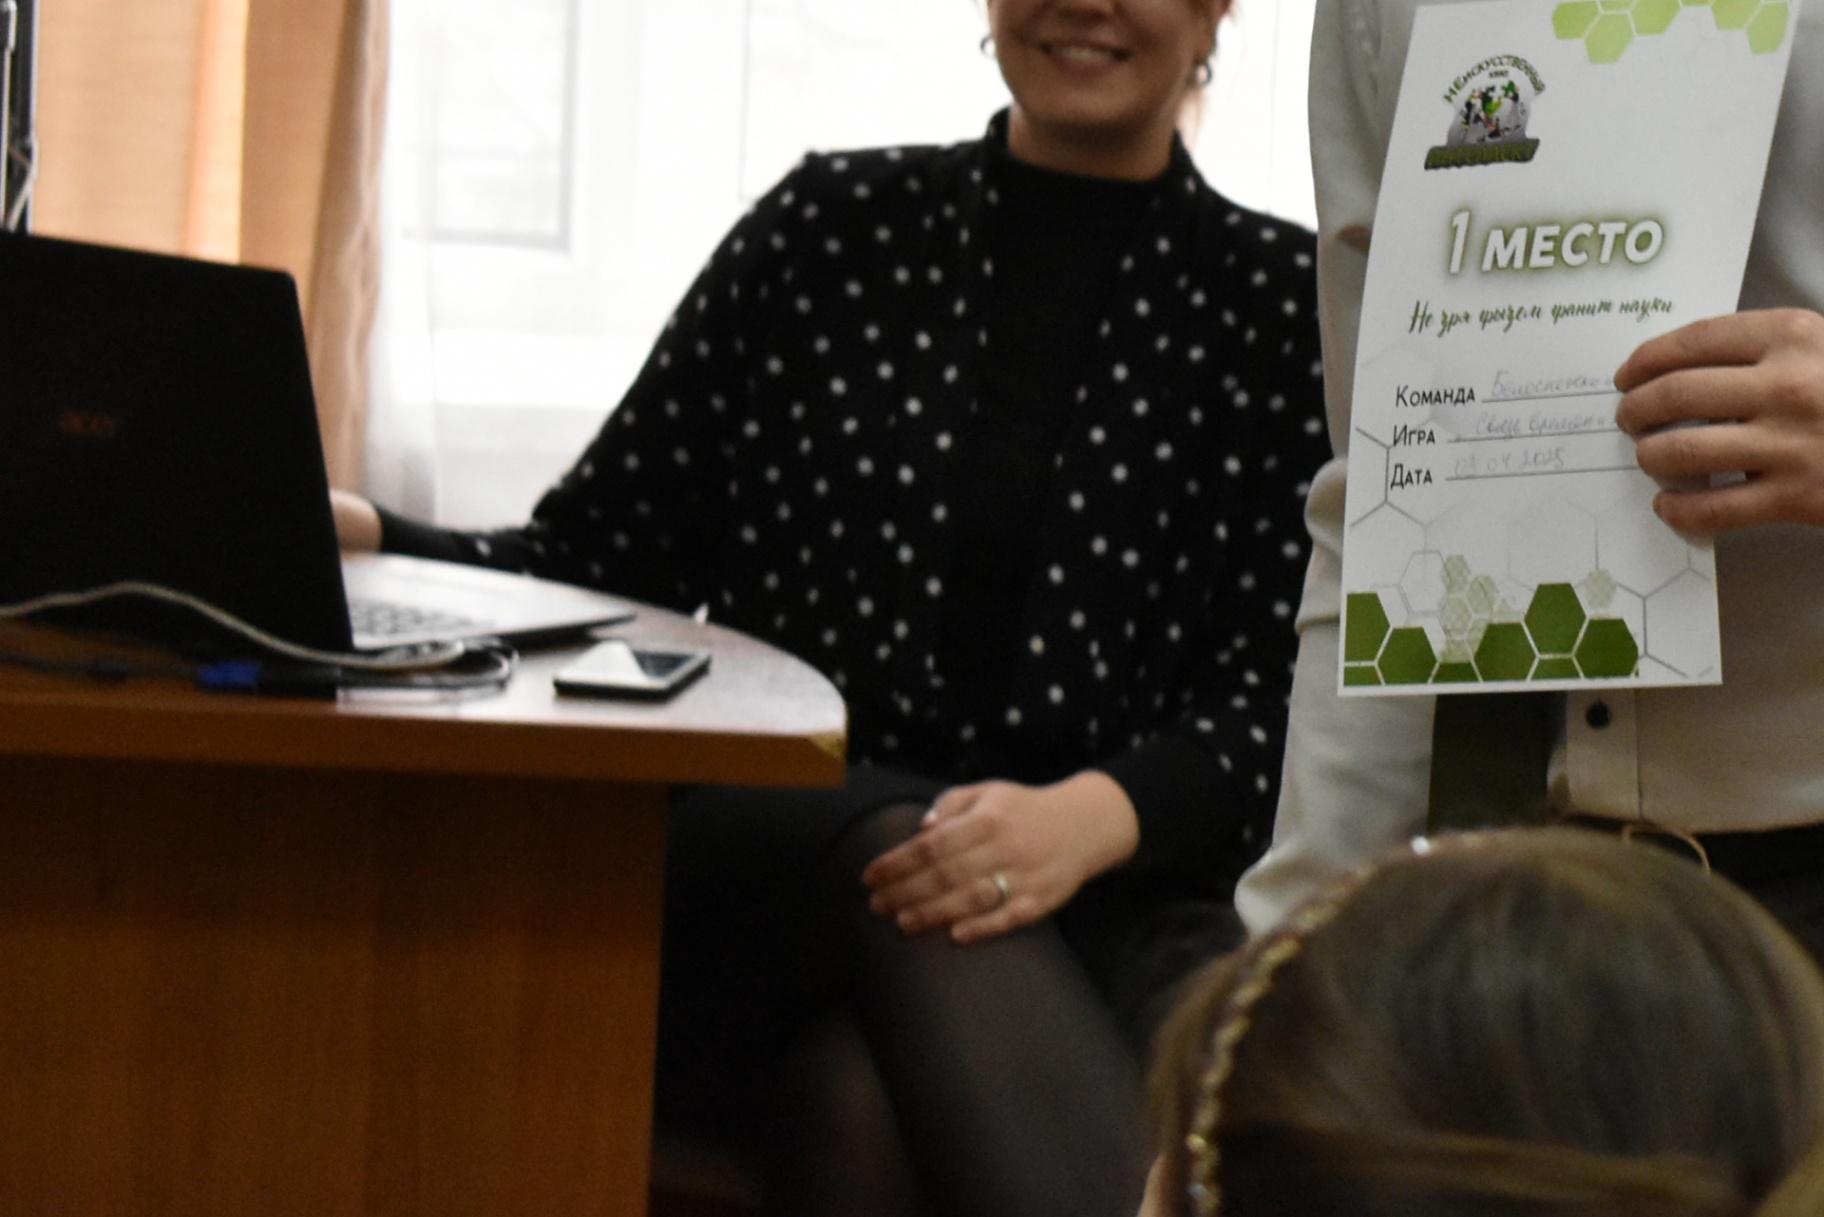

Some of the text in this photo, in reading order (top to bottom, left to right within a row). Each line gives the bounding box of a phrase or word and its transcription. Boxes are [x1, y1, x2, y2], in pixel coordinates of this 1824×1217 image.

[1448, 209, 1665, 274] 1 МЕСТО
[1408, 300, 1433, 334] Не
[1435, 307, 1471, 338] зря
[1619, 295, 1673, 323] науки
